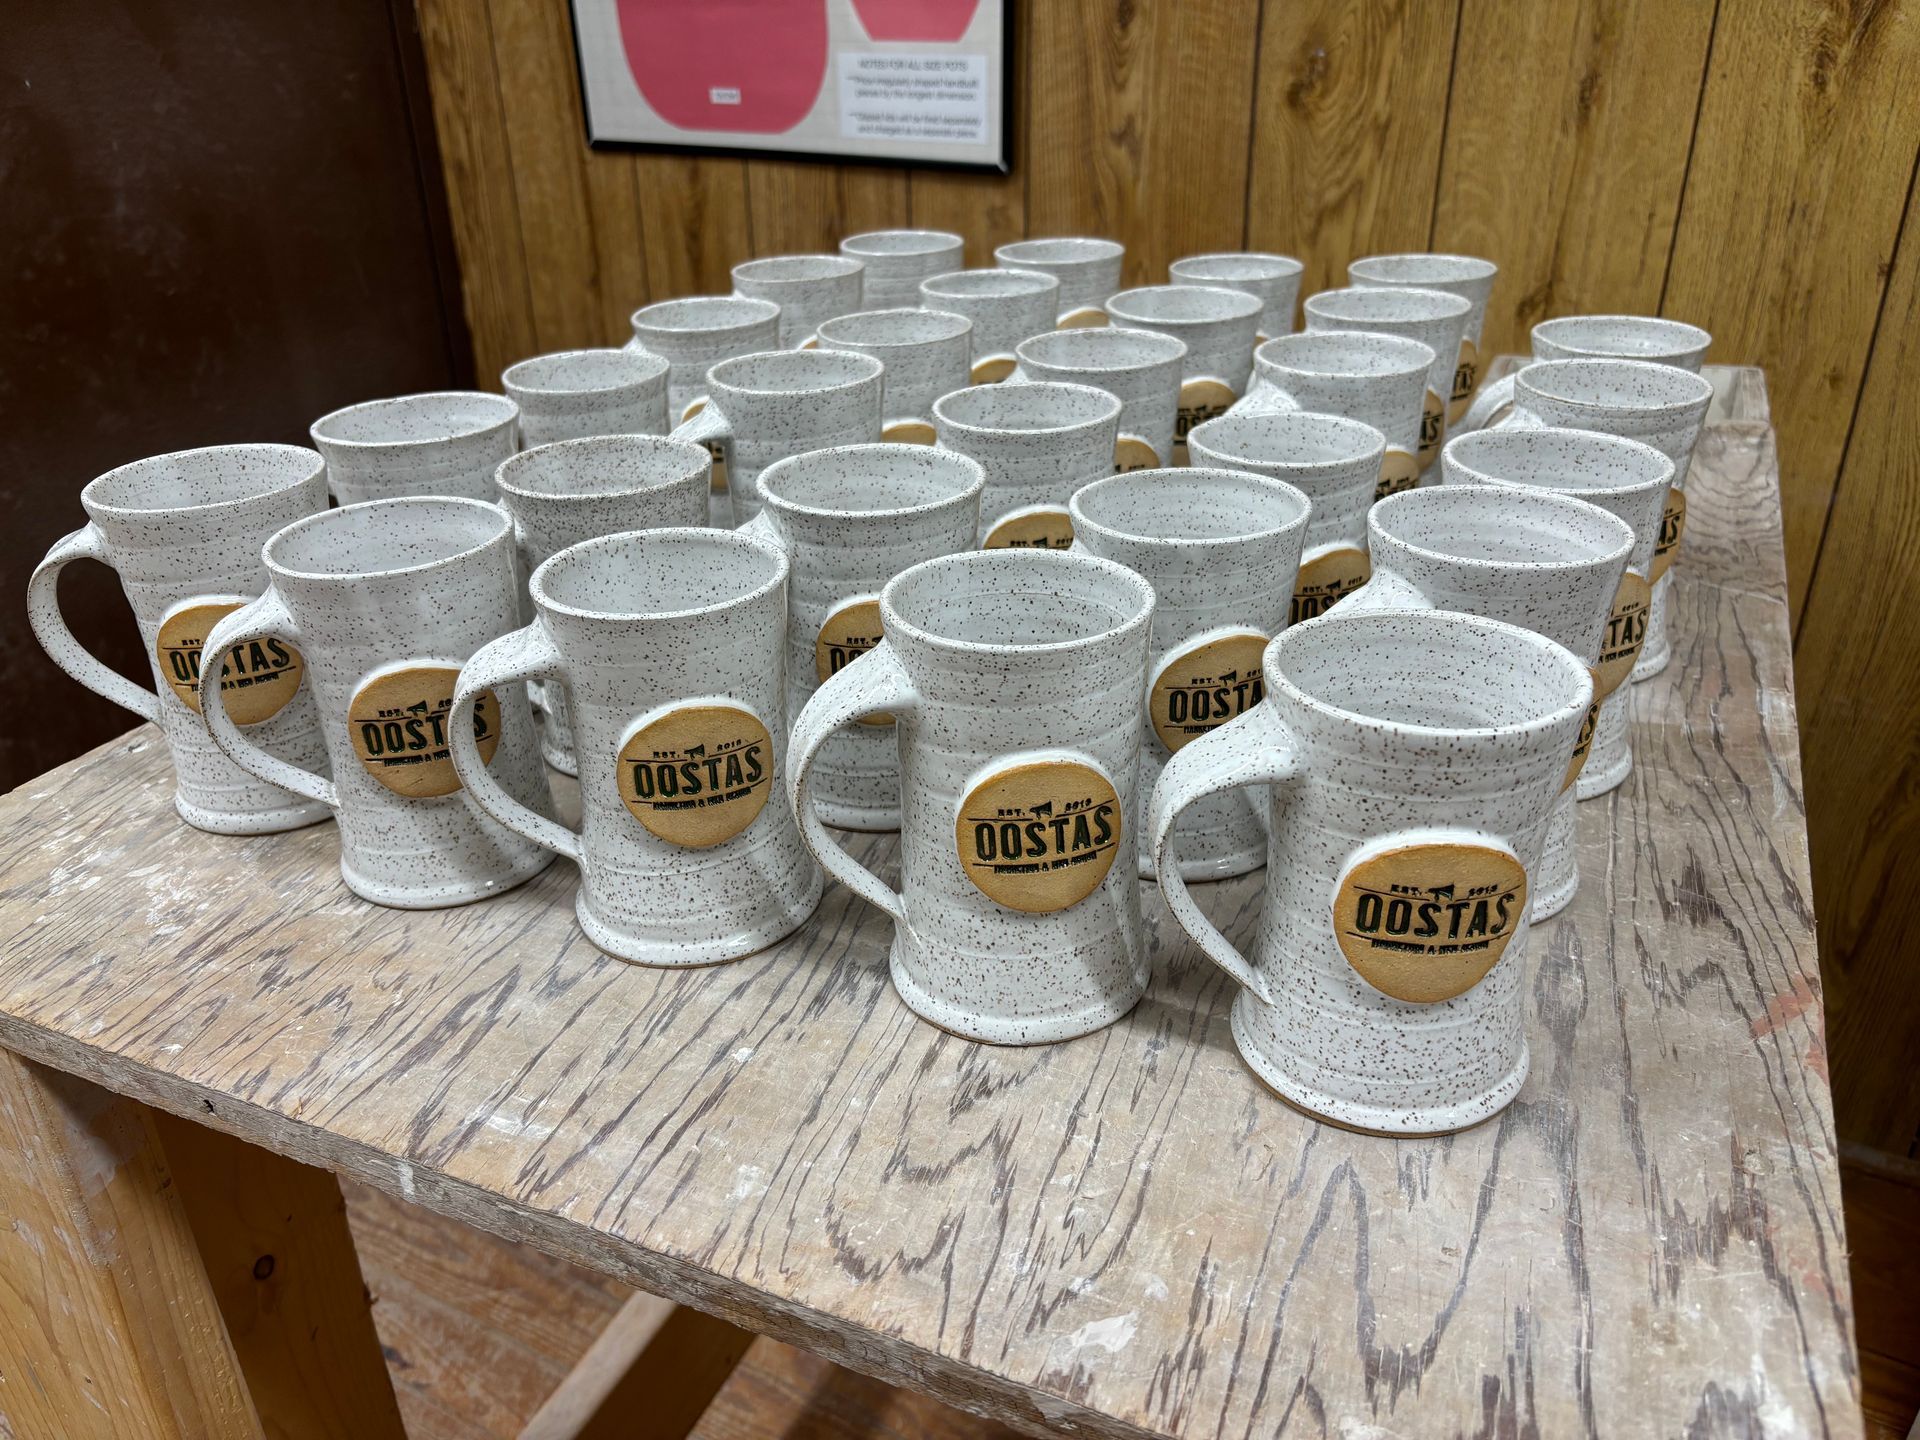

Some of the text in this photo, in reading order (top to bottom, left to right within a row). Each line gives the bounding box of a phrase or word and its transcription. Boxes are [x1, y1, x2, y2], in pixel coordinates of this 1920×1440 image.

[1602, 608, 1647, 649] TAS
[169, 638, 290, 682] OOTAS
[1168, 680, 1264, 723] OOSTA
[361, 703, 488, 757] OOSTS
[633, 745, 762, 799] OOSTAS
[653, 751, 680, 759] EST.
[974, 805, 1113, 862] OOSTAS
[997, 808, 1026, 817] EST.
[1355, 892, 1516, 940] OOSTAS
